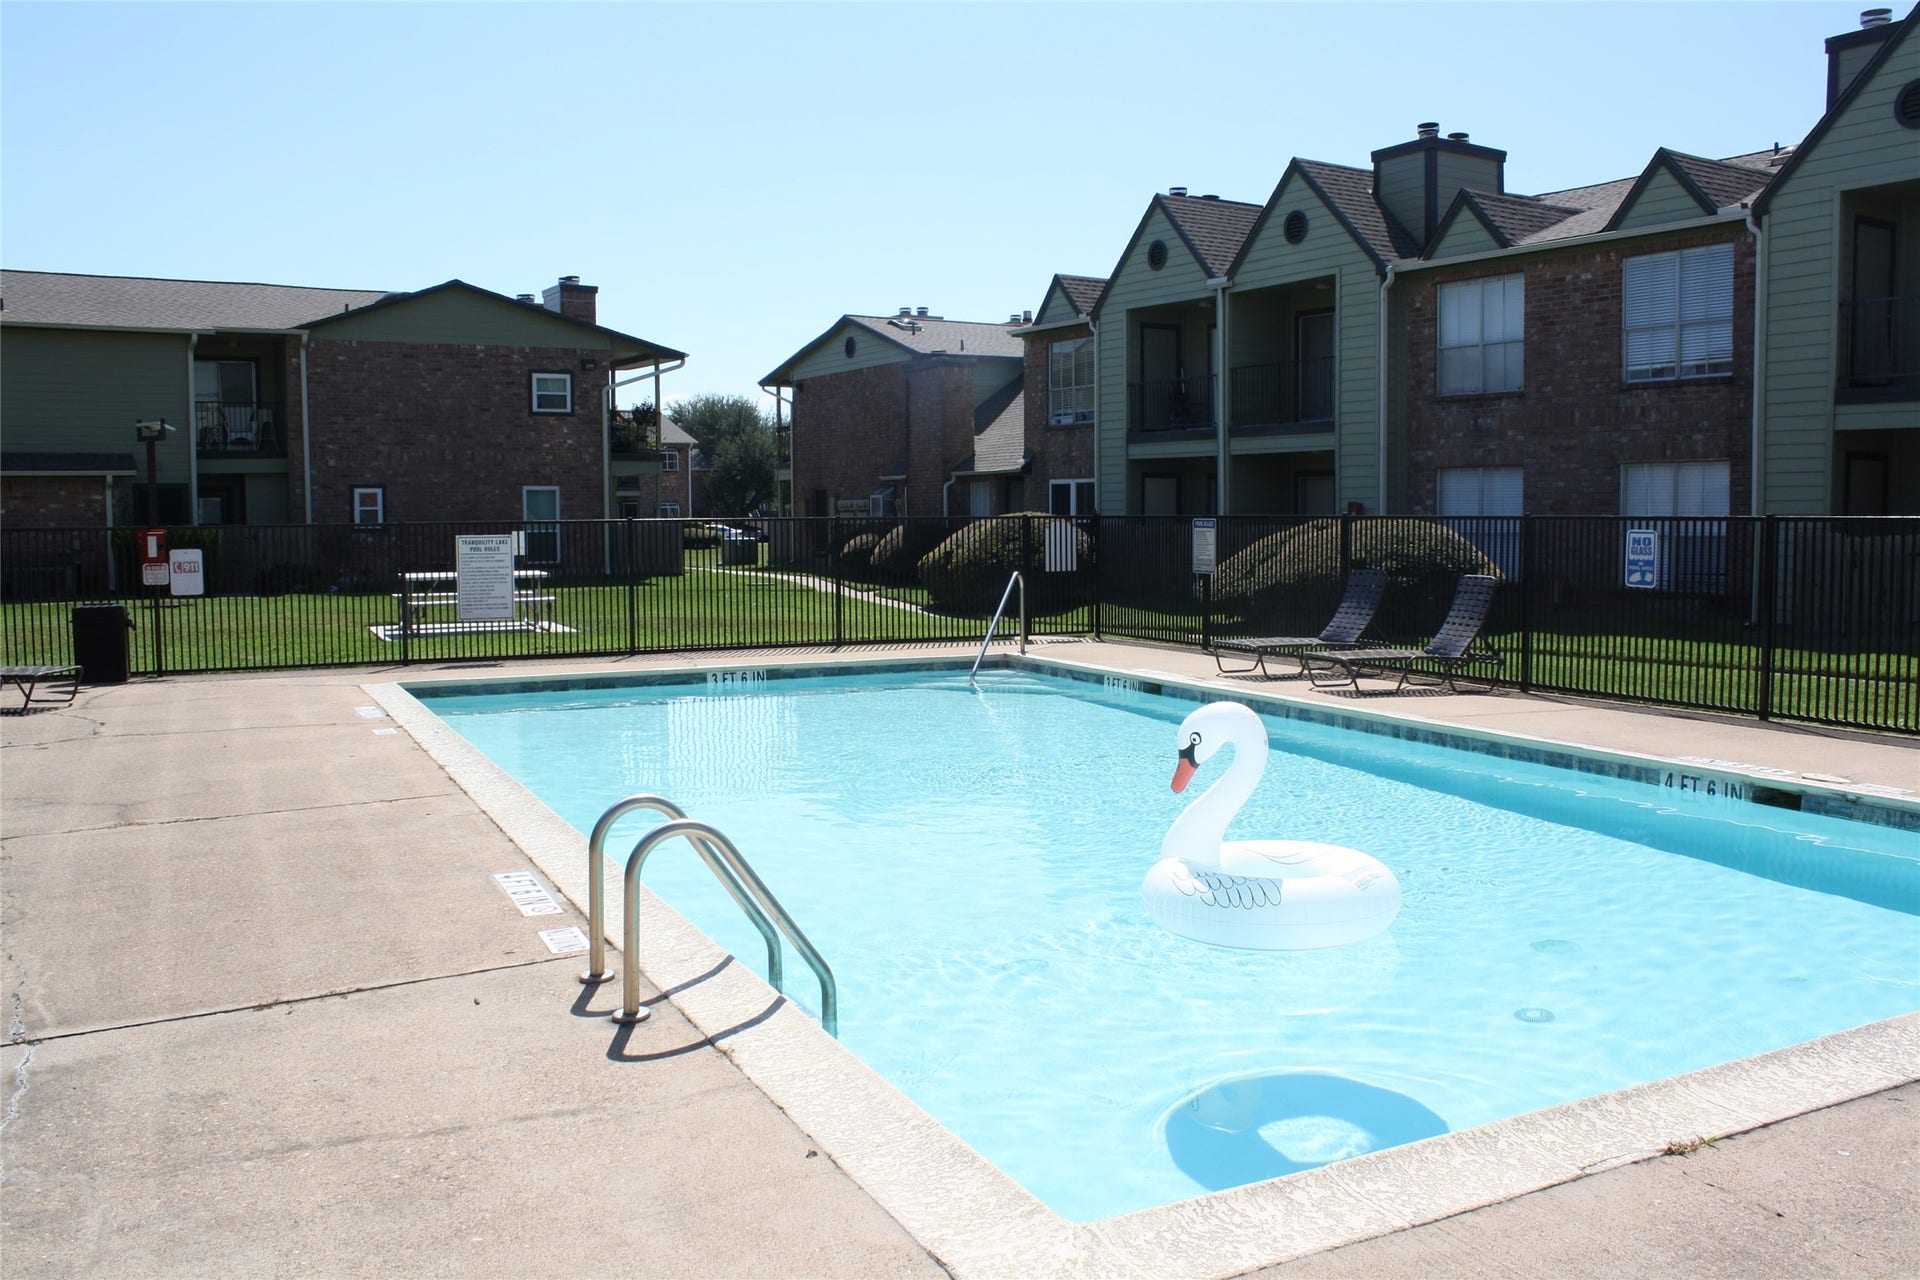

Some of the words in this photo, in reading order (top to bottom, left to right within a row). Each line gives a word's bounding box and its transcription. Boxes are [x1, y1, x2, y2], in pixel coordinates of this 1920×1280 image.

[1632, 536, 1652, 546] NO
[1630, 546, 1652, 556] GLASS
[184, 562, 199, 572] 911
[722, 672, 736, 684] FT
[752, 670, 764, 682] IN
[1665, 772, 1674, 788] 4
[1680, 774, 1700, 792] FT
[1706, 780, 1716, 796] 6
[1724, 782, 1742, 800] IN
